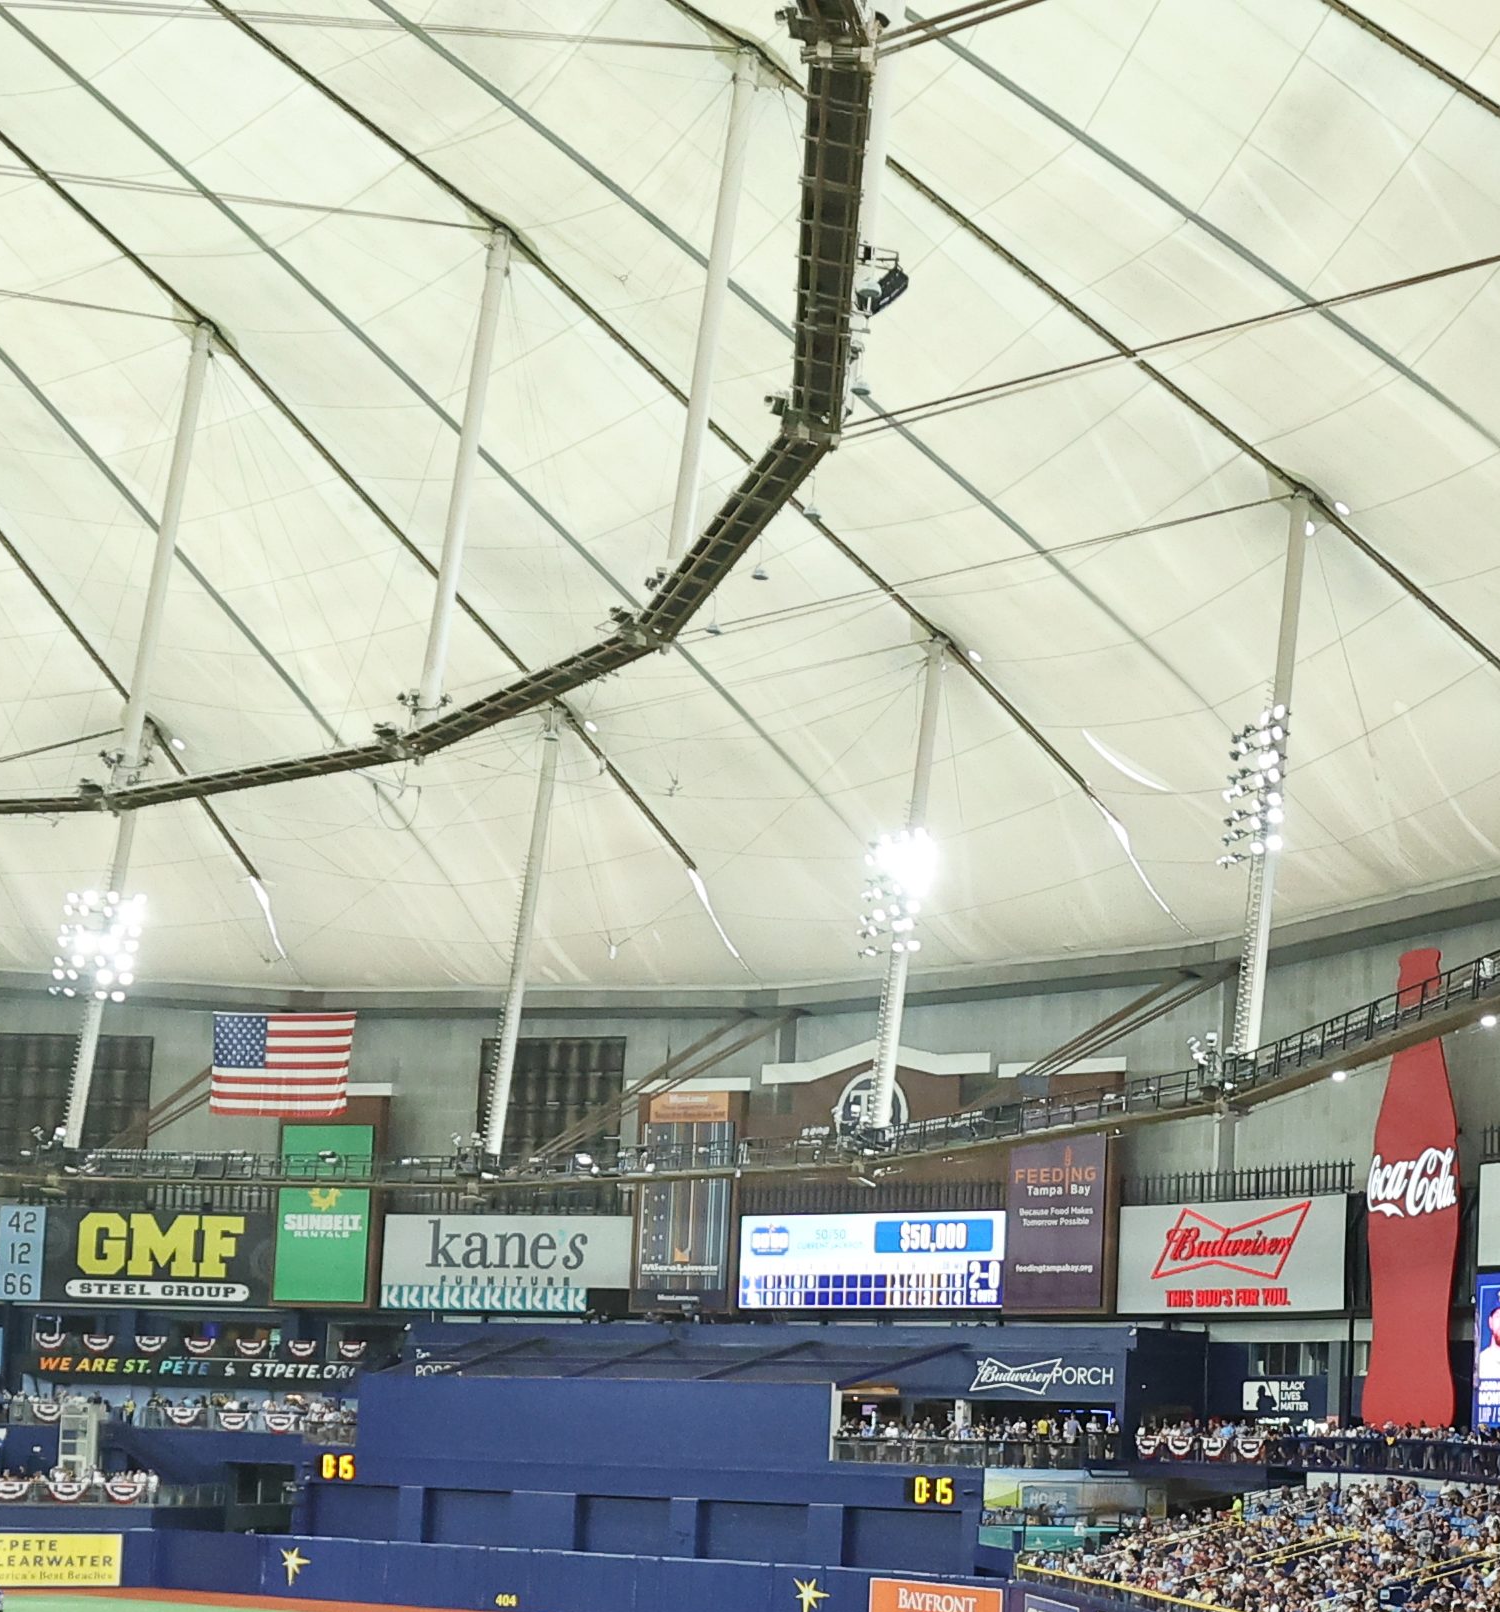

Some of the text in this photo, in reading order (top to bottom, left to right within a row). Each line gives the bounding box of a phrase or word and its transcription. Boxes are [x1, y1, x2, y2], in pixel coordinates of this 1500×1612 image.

[1015, 1166, 1097, 1184] FEEDING
[1367, 1146, 1458, 1218] Coca-Cola
[1027, 1183, 1091, 1197] Tampa Bay
[8, 1212, 37, 1233] 42
[284, 1213, 362, 1231] SUNBELT
[294, 1230, 349, 1239] RENTALS
[425, 1218, 588, 1270] kane's
[900, 1221, 967, 1252] $50,000
[1166, 1226, 1293, 1261] Budweiser
[10, 1243, 31, 1265] 12
[77, 1212, 245, 1279] GMF
[968, 1261, 1000, 1289] 2-0
[1016, 1263, 1093, 1273] feedingtampabay.org
[4, 1273, 32, 1296] 66
[79, 1282, 236, 1298] STEEL GROUP
[440, 1275, 571, 1287] FURNITURE
[1165, 1287, 1291, 1307] THIS BUD'S FOR YOU.
[39, 1356, 210, 1376] WE ARE ST. PETE
[977, 1363, 1114, 1386] Budweiser PORCH
[1280, 1381, 1306, 1392] BLACK
[1280, 1391, 1301, 1401] LIVES
[1280, 1401, 1309, 1412] MATTER
[914, 1476, 953, 1505] 0:15
[39, 1570, 63, 1580] Best
[67, 1571, 113, 1580] Beaches
[495, 1593, 517, 1607] 404
